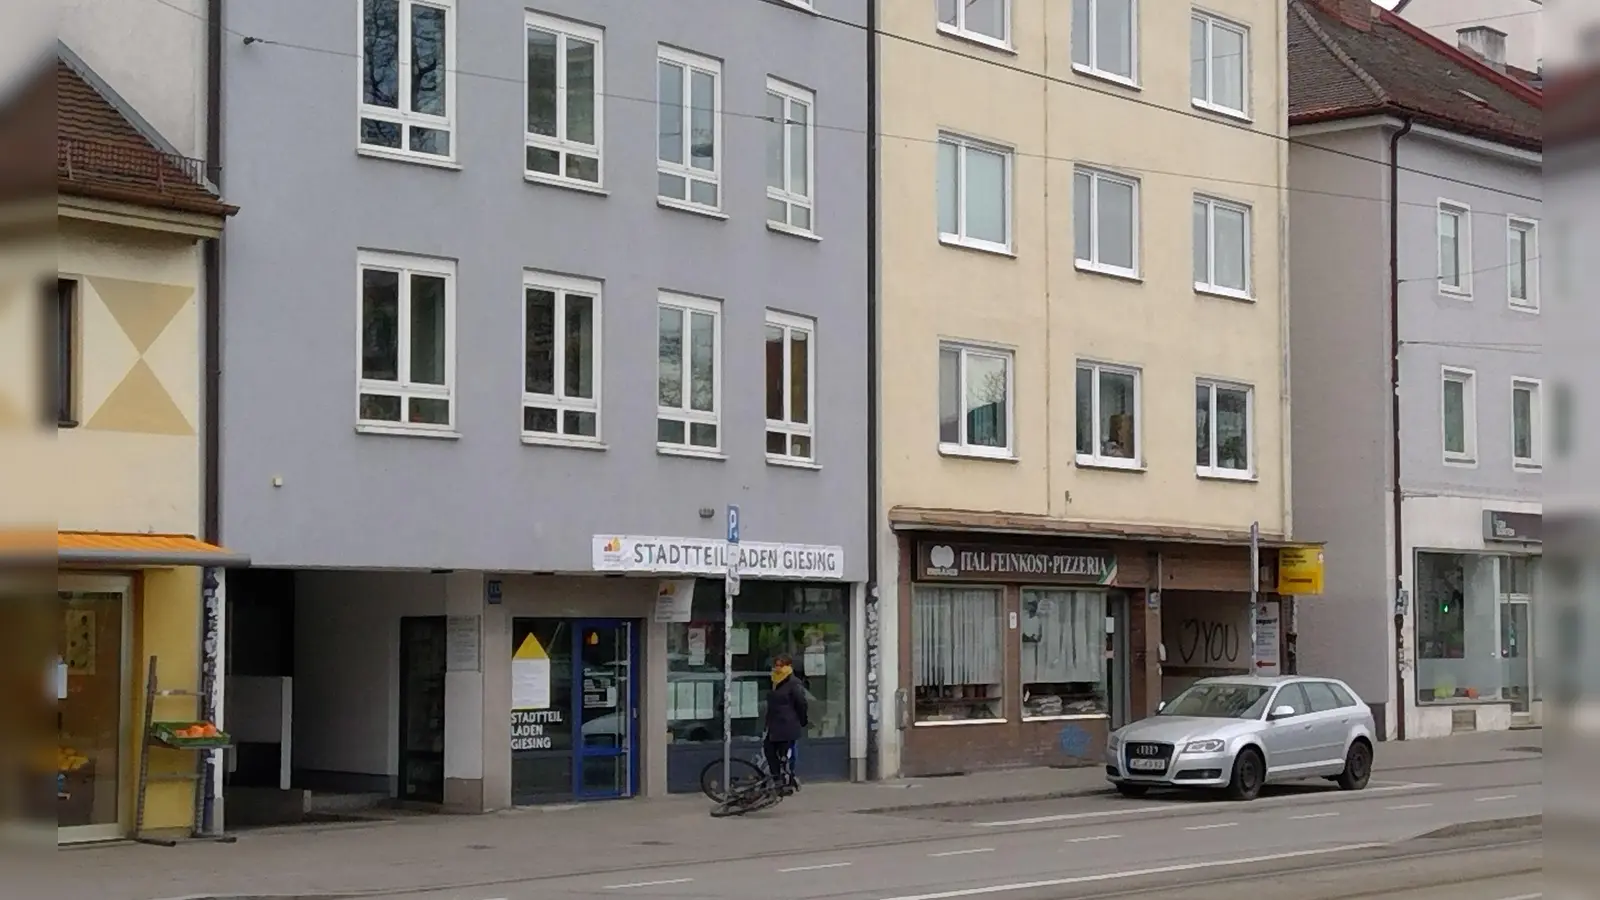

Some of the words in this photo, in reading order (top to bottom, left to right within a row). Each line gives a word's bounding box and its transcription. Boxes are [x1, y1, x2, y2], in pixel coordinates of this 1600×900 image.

[783, 550, 835, 571] GIESING
[1201, 620, 1239, 663] YOU
[511, 711, 562, 724] STADTTEIL
[511, 725, 543, 736] LADEN
[511, 737, 551, 750] GIESING
